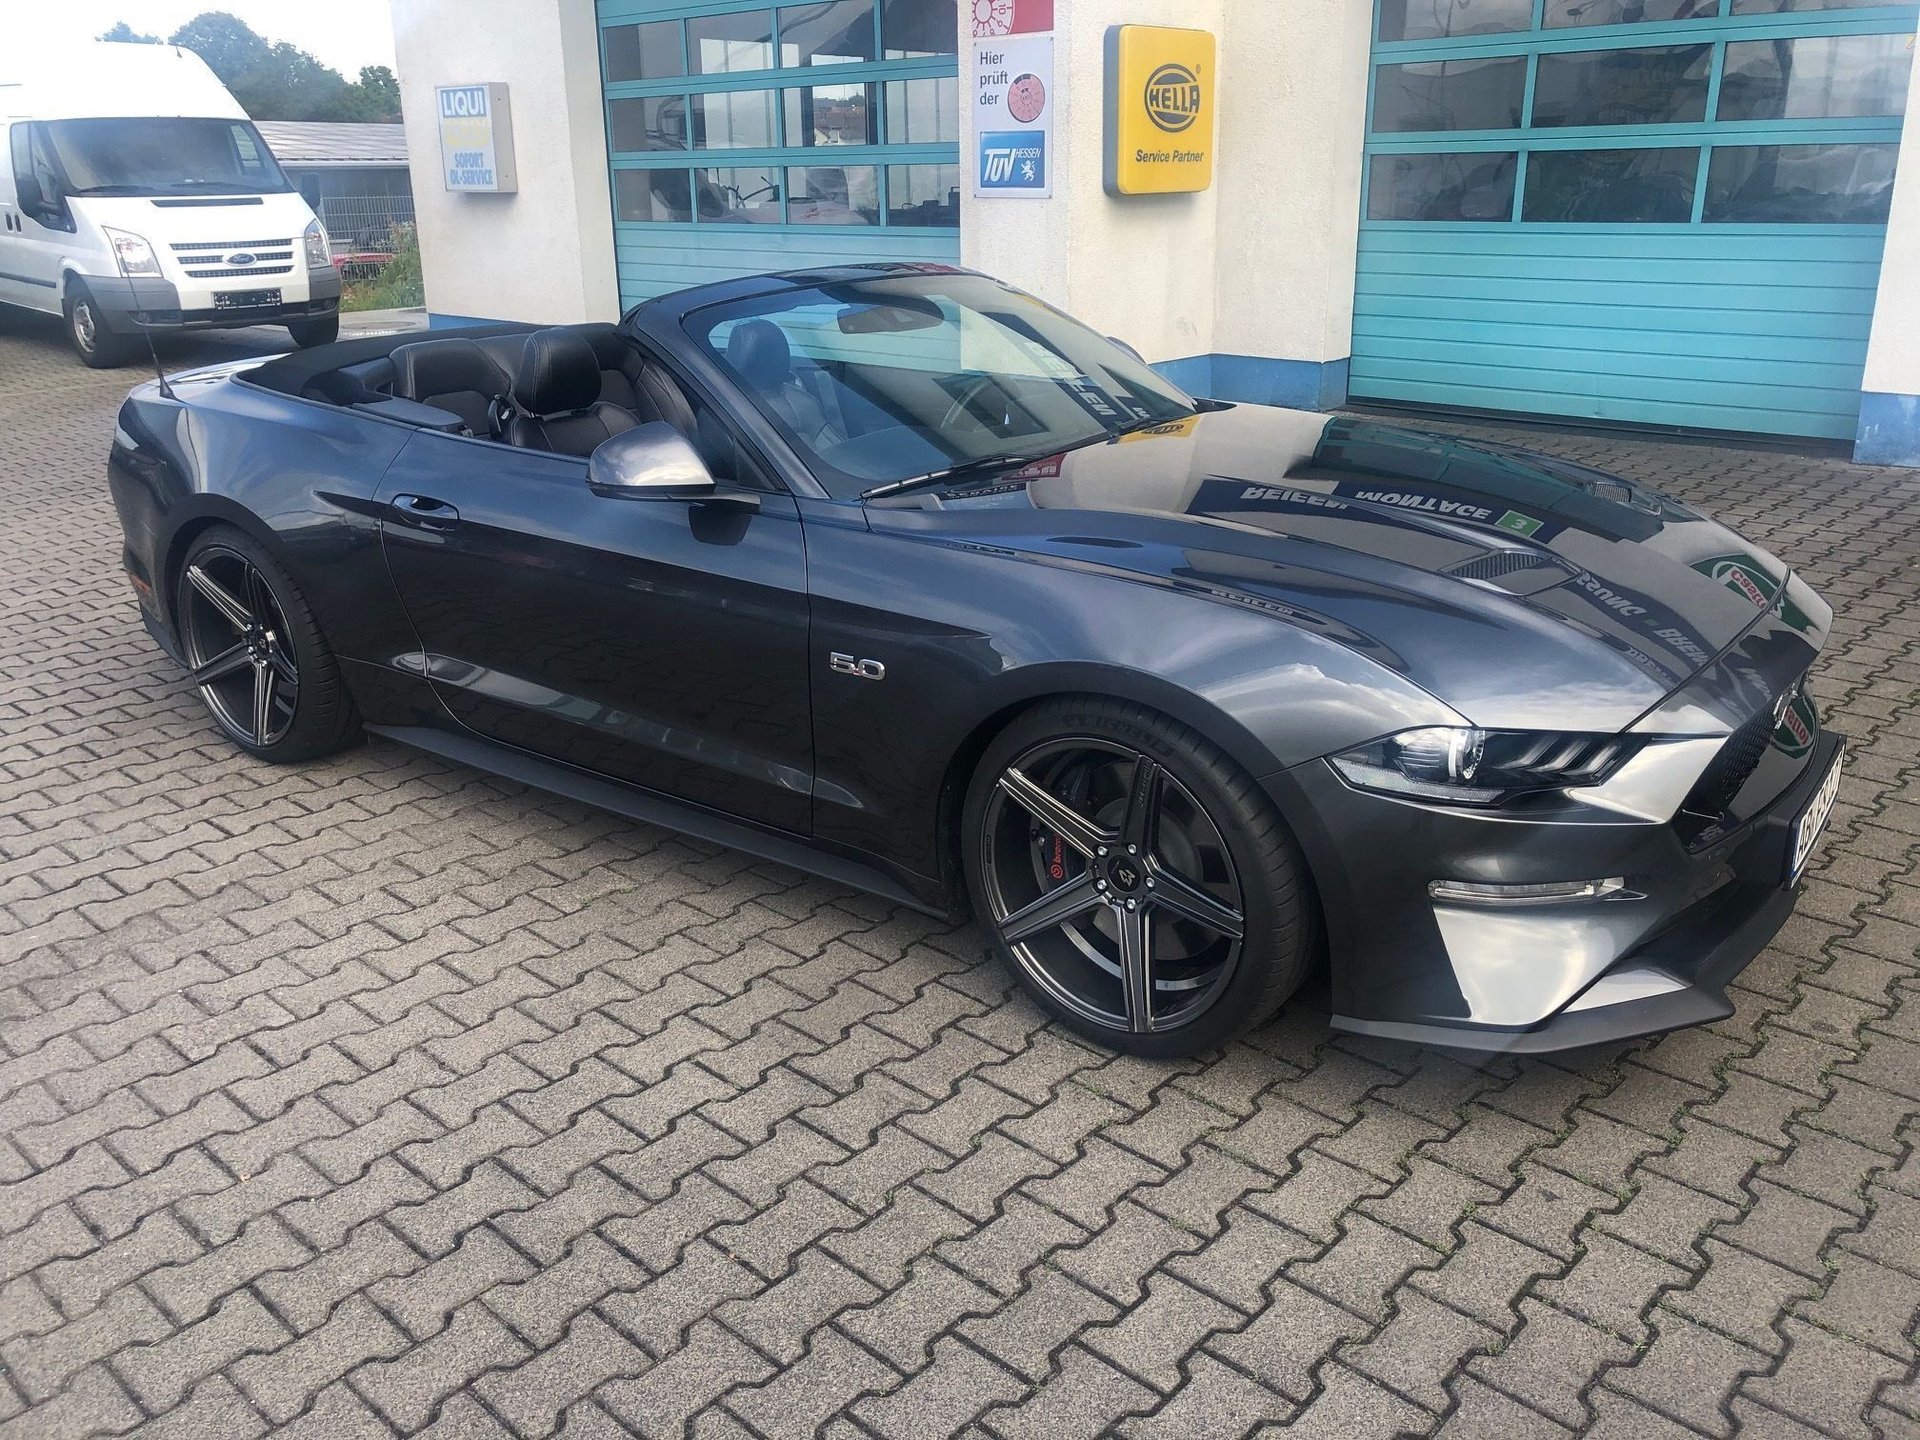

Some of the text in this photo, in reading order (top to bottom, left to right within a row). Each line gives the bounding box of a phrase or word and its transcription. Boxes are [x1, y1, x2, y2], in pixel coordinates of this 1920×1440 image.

[980, 51, 1005, 66] Hier
[980, 70, 1008, 89] prüft
[442, 90, 485, 116] LIQUI
[979, 91, 999, 106] der
[1149, 85, 1200, 113] HELLA
[455, 152, 483, 168] SOFORT
[1135, 148, 1205, 163] Service Partner
[830, 651, 886, 681] 5.0
